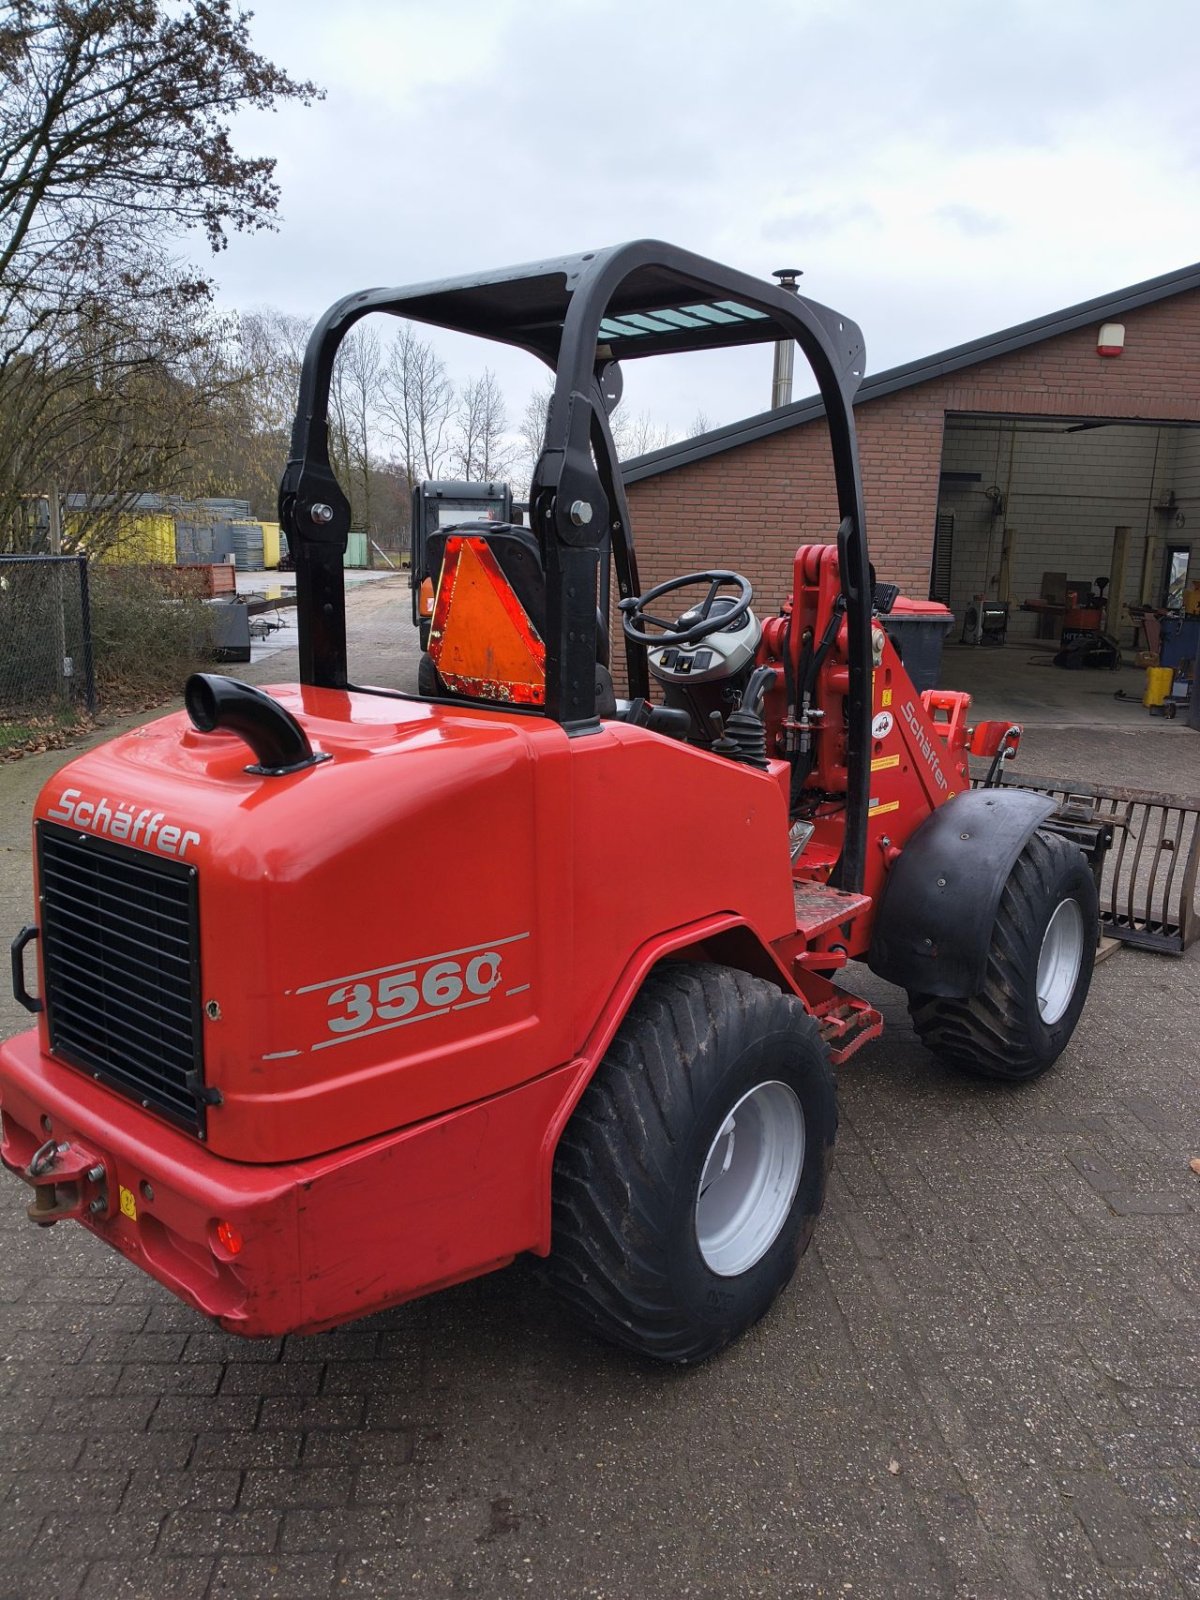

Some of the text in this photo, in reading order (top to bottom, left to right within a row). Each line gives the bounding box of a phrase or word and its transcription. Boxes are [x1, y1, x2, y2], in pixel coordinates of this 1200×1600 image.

[901, 701, 948, 790] Schäffer
[48, 788, 200, 856] Schäffer
[327, 952, 502, 1033] 3560
